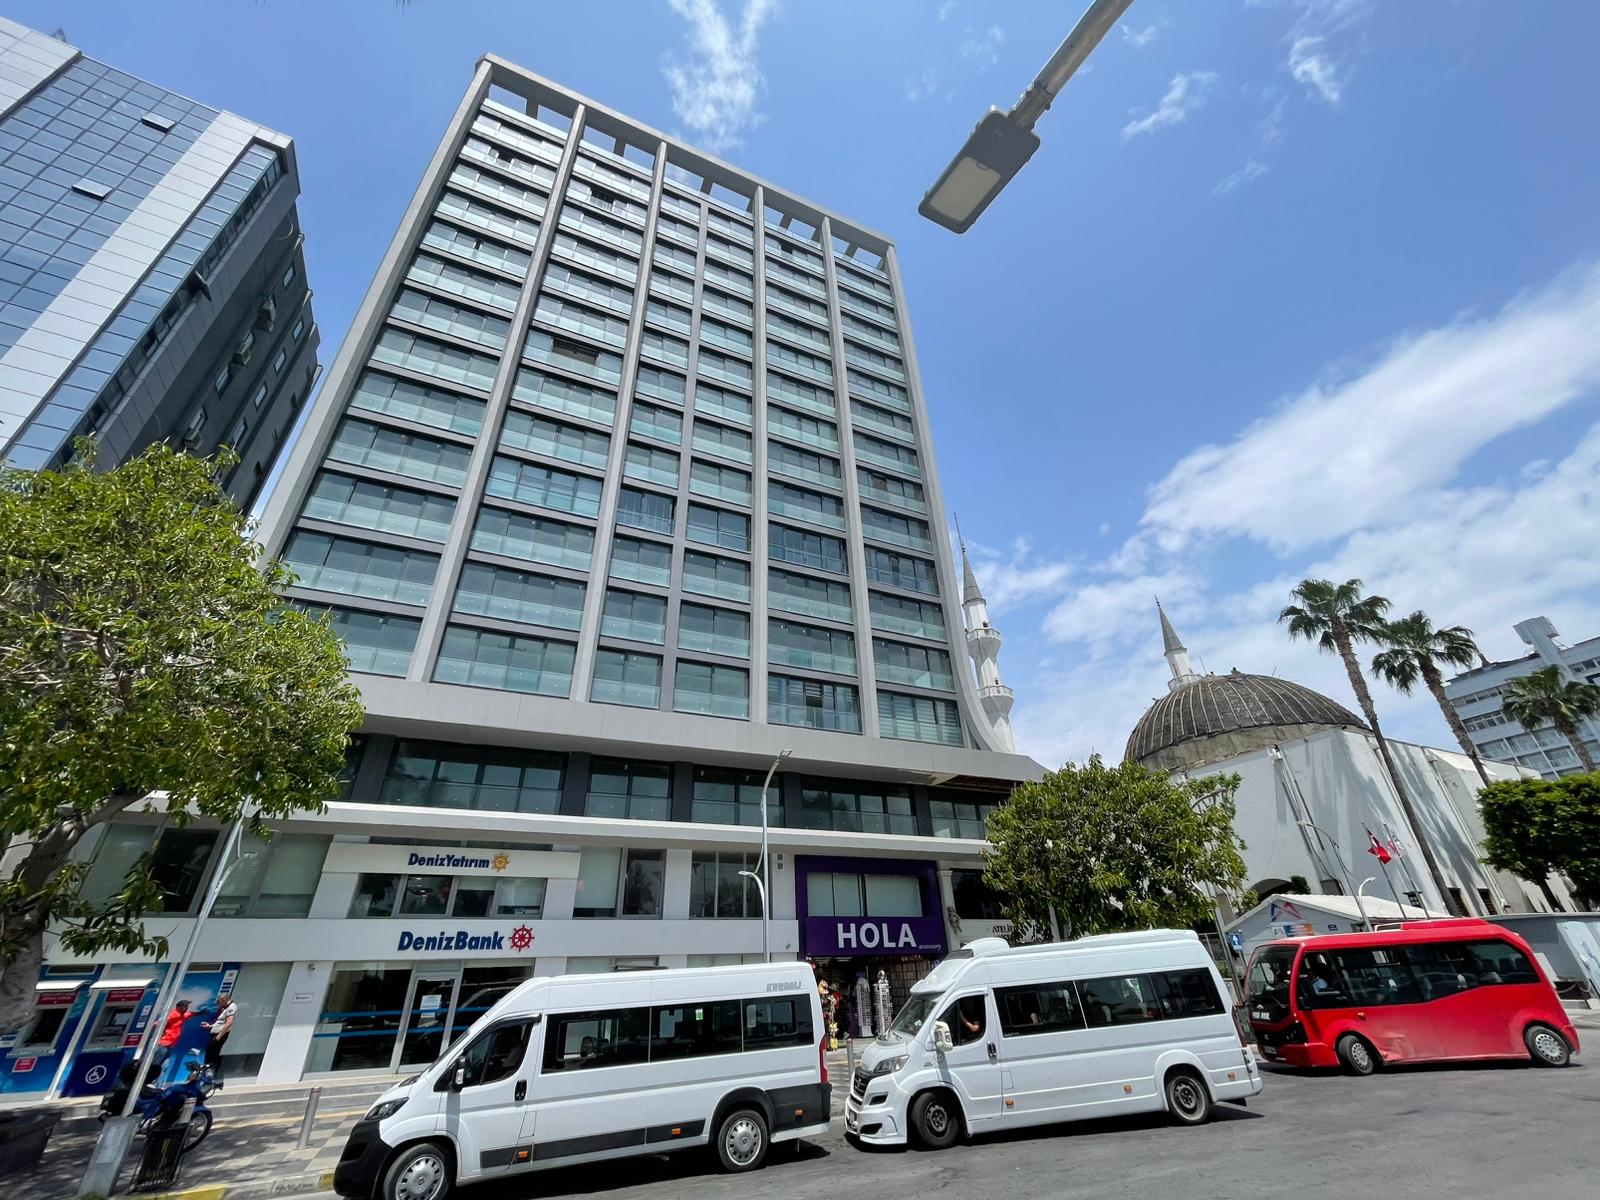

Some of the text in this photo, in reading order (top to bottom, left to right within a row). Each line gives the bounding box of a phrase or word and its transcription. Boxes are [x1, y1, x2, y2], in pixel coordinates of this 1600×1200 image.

[408, 853, 490, 868] DenizYatırım
[397, 931, 504, 951] DenizBank
[837, 923, 917, 948] HOLA
